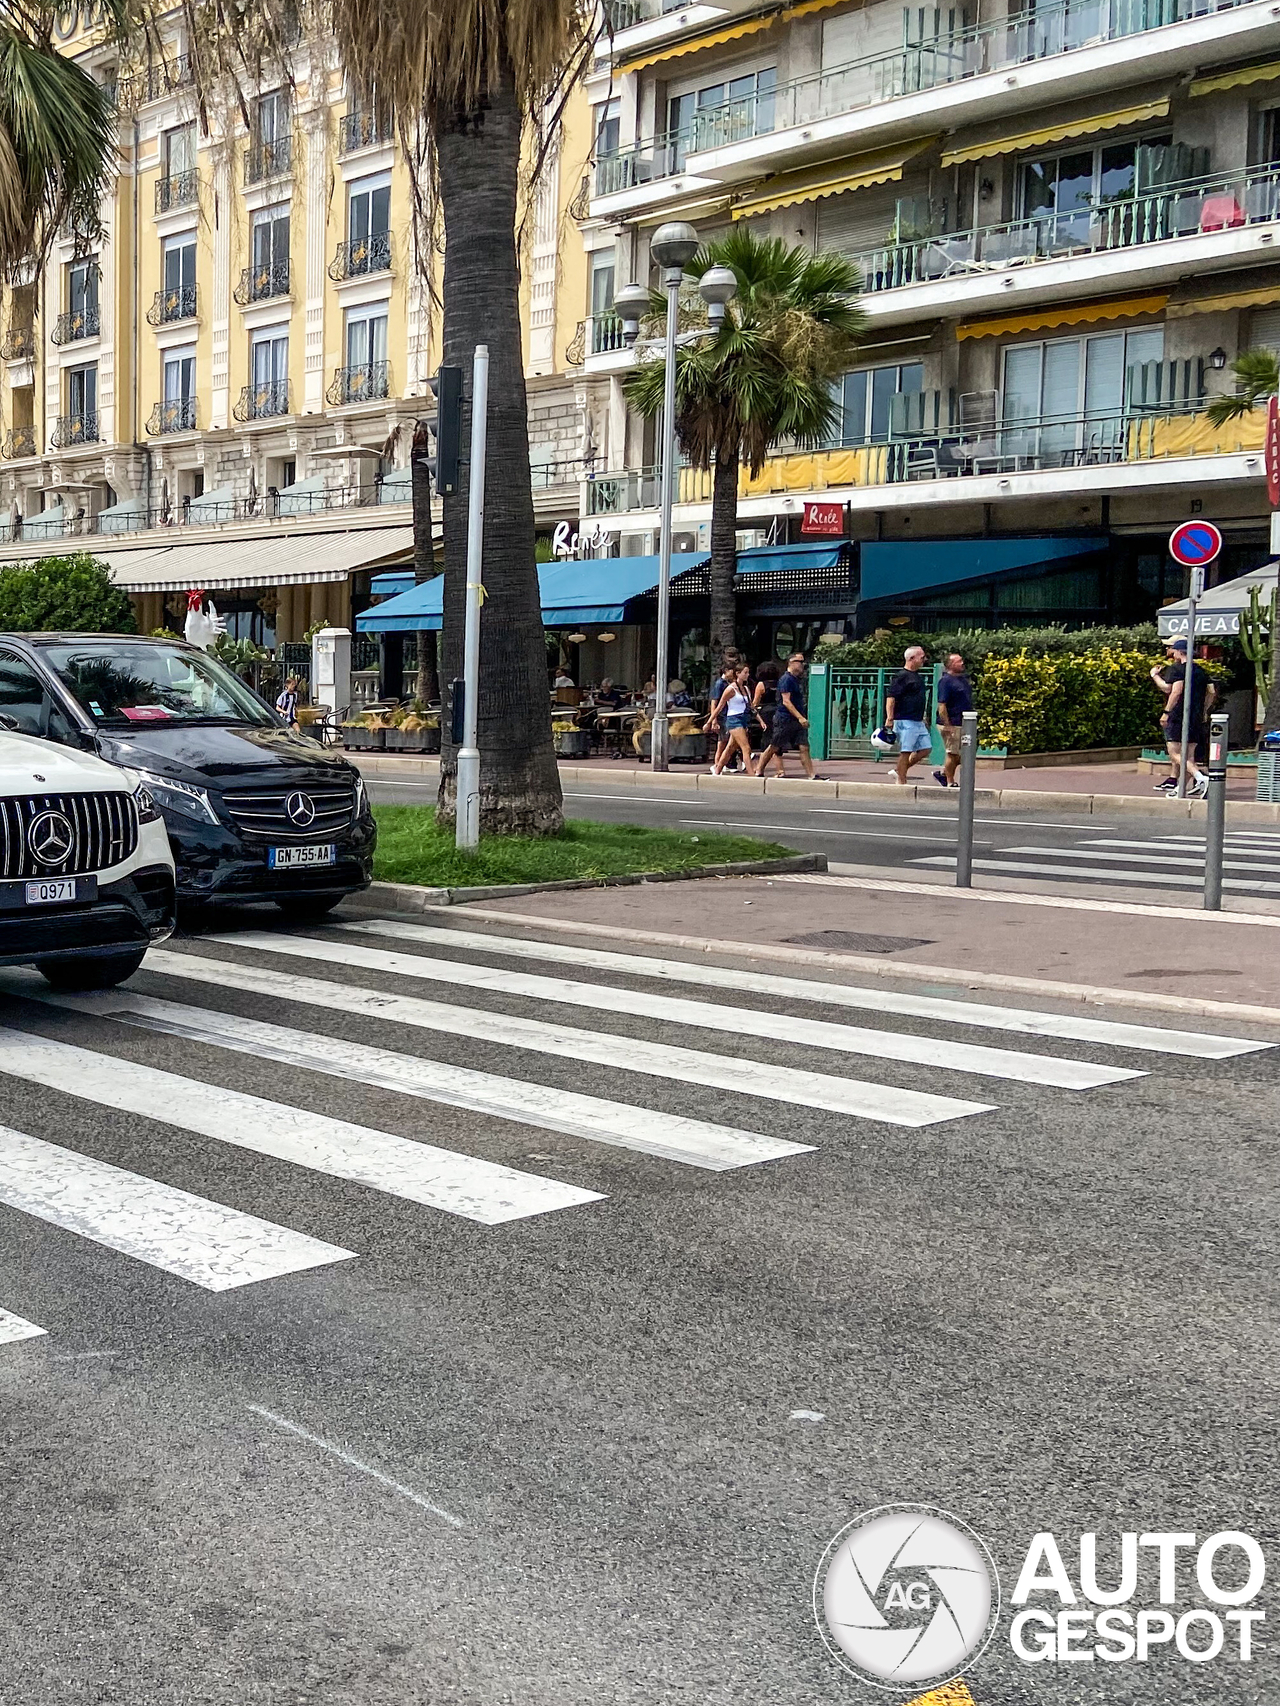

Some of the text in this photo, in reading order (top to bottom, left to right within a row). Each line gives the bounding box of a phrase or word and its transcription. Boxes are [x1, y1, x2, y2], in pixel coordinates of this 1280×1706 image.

[1271, 418, 1279, 484] TABAC
[552, 520, 615, 556] Renée
[1214, 617, 1228, 632] A
[277, 846, 329, 863] GN-755-AA
[40, 882, 72, 900] Q971
